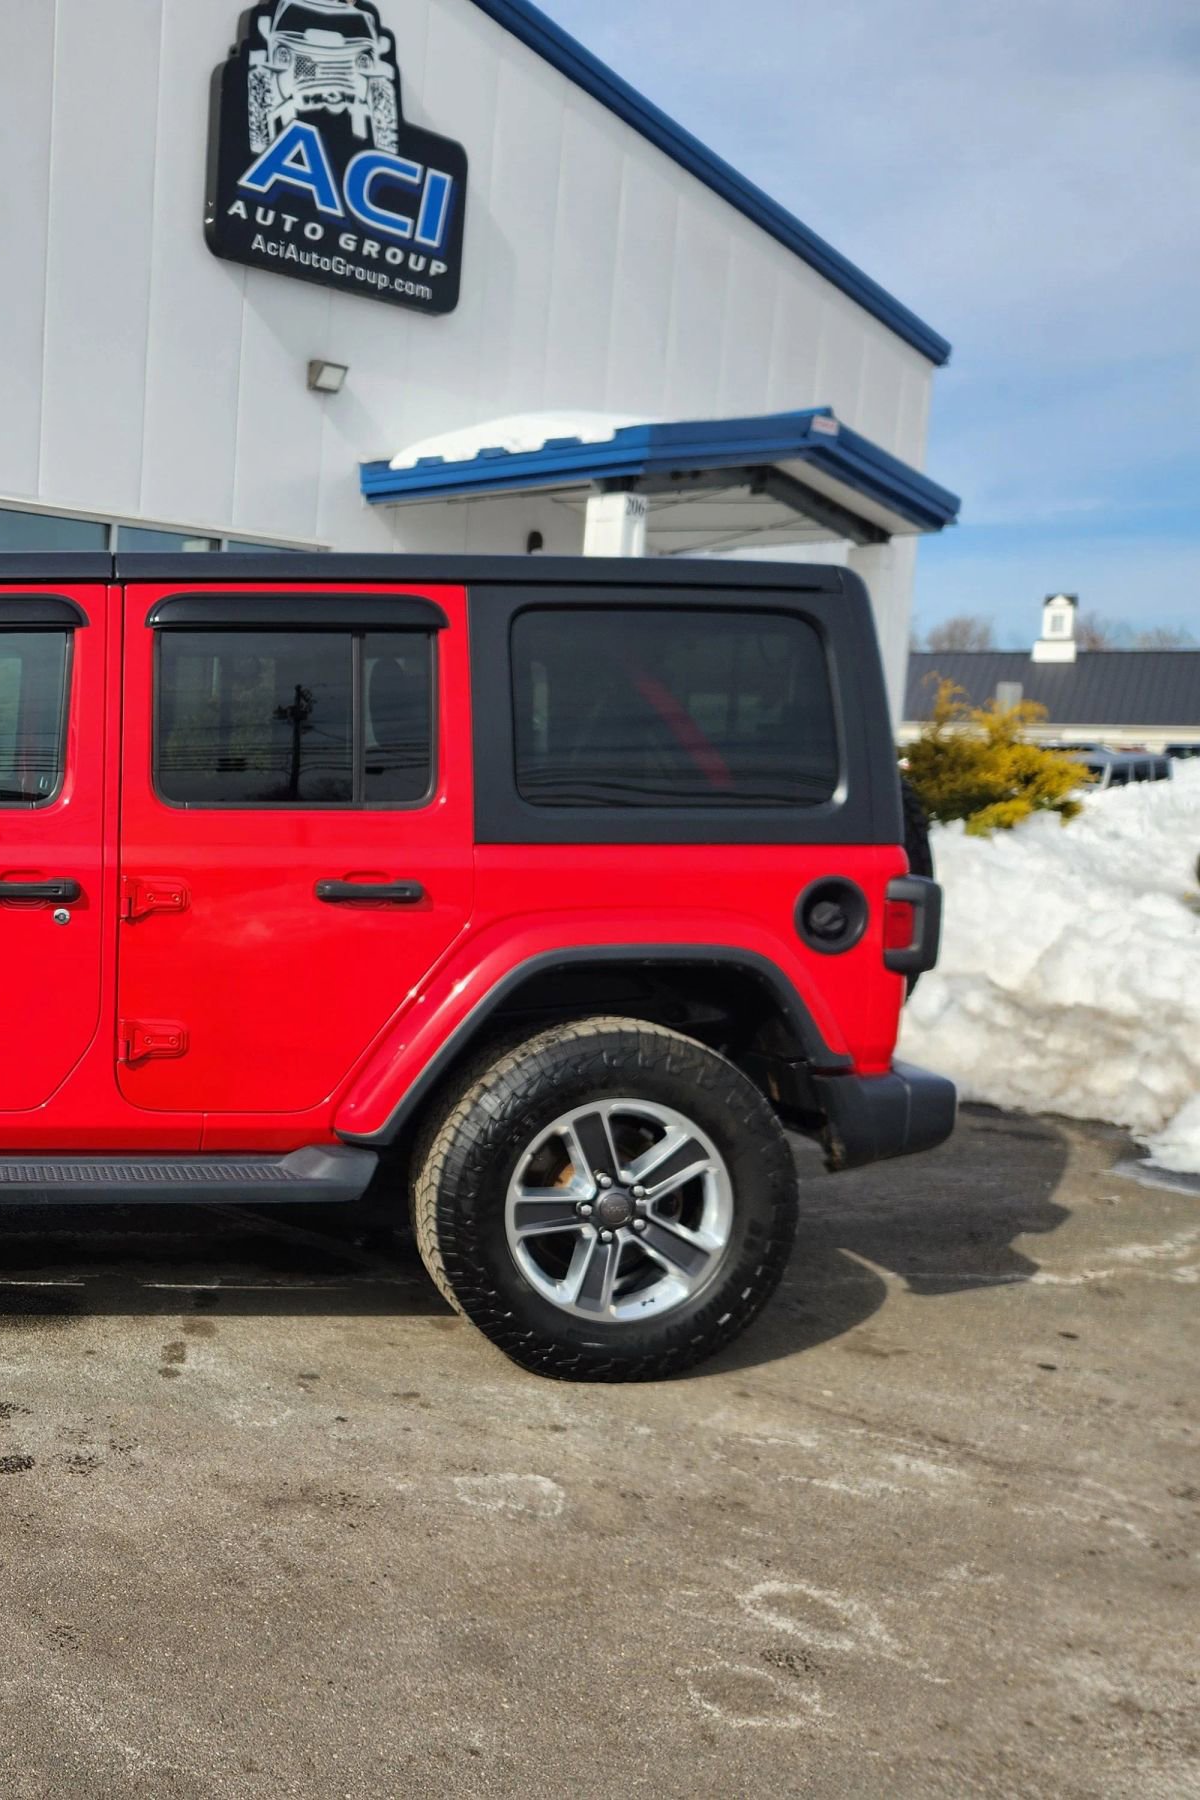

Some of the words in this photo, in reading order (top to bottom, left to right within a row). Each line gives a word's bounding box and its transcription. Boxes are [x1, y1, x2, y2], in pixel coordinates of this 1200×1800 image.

[237, 119, 454, 249] ACI
[227, 199, 325, 242] AUTO
[337, 231, 449, 278] GROUP
[250, 234, 433, 301] AciAutoGroup.com
[625, 496, 646, 516] 206
